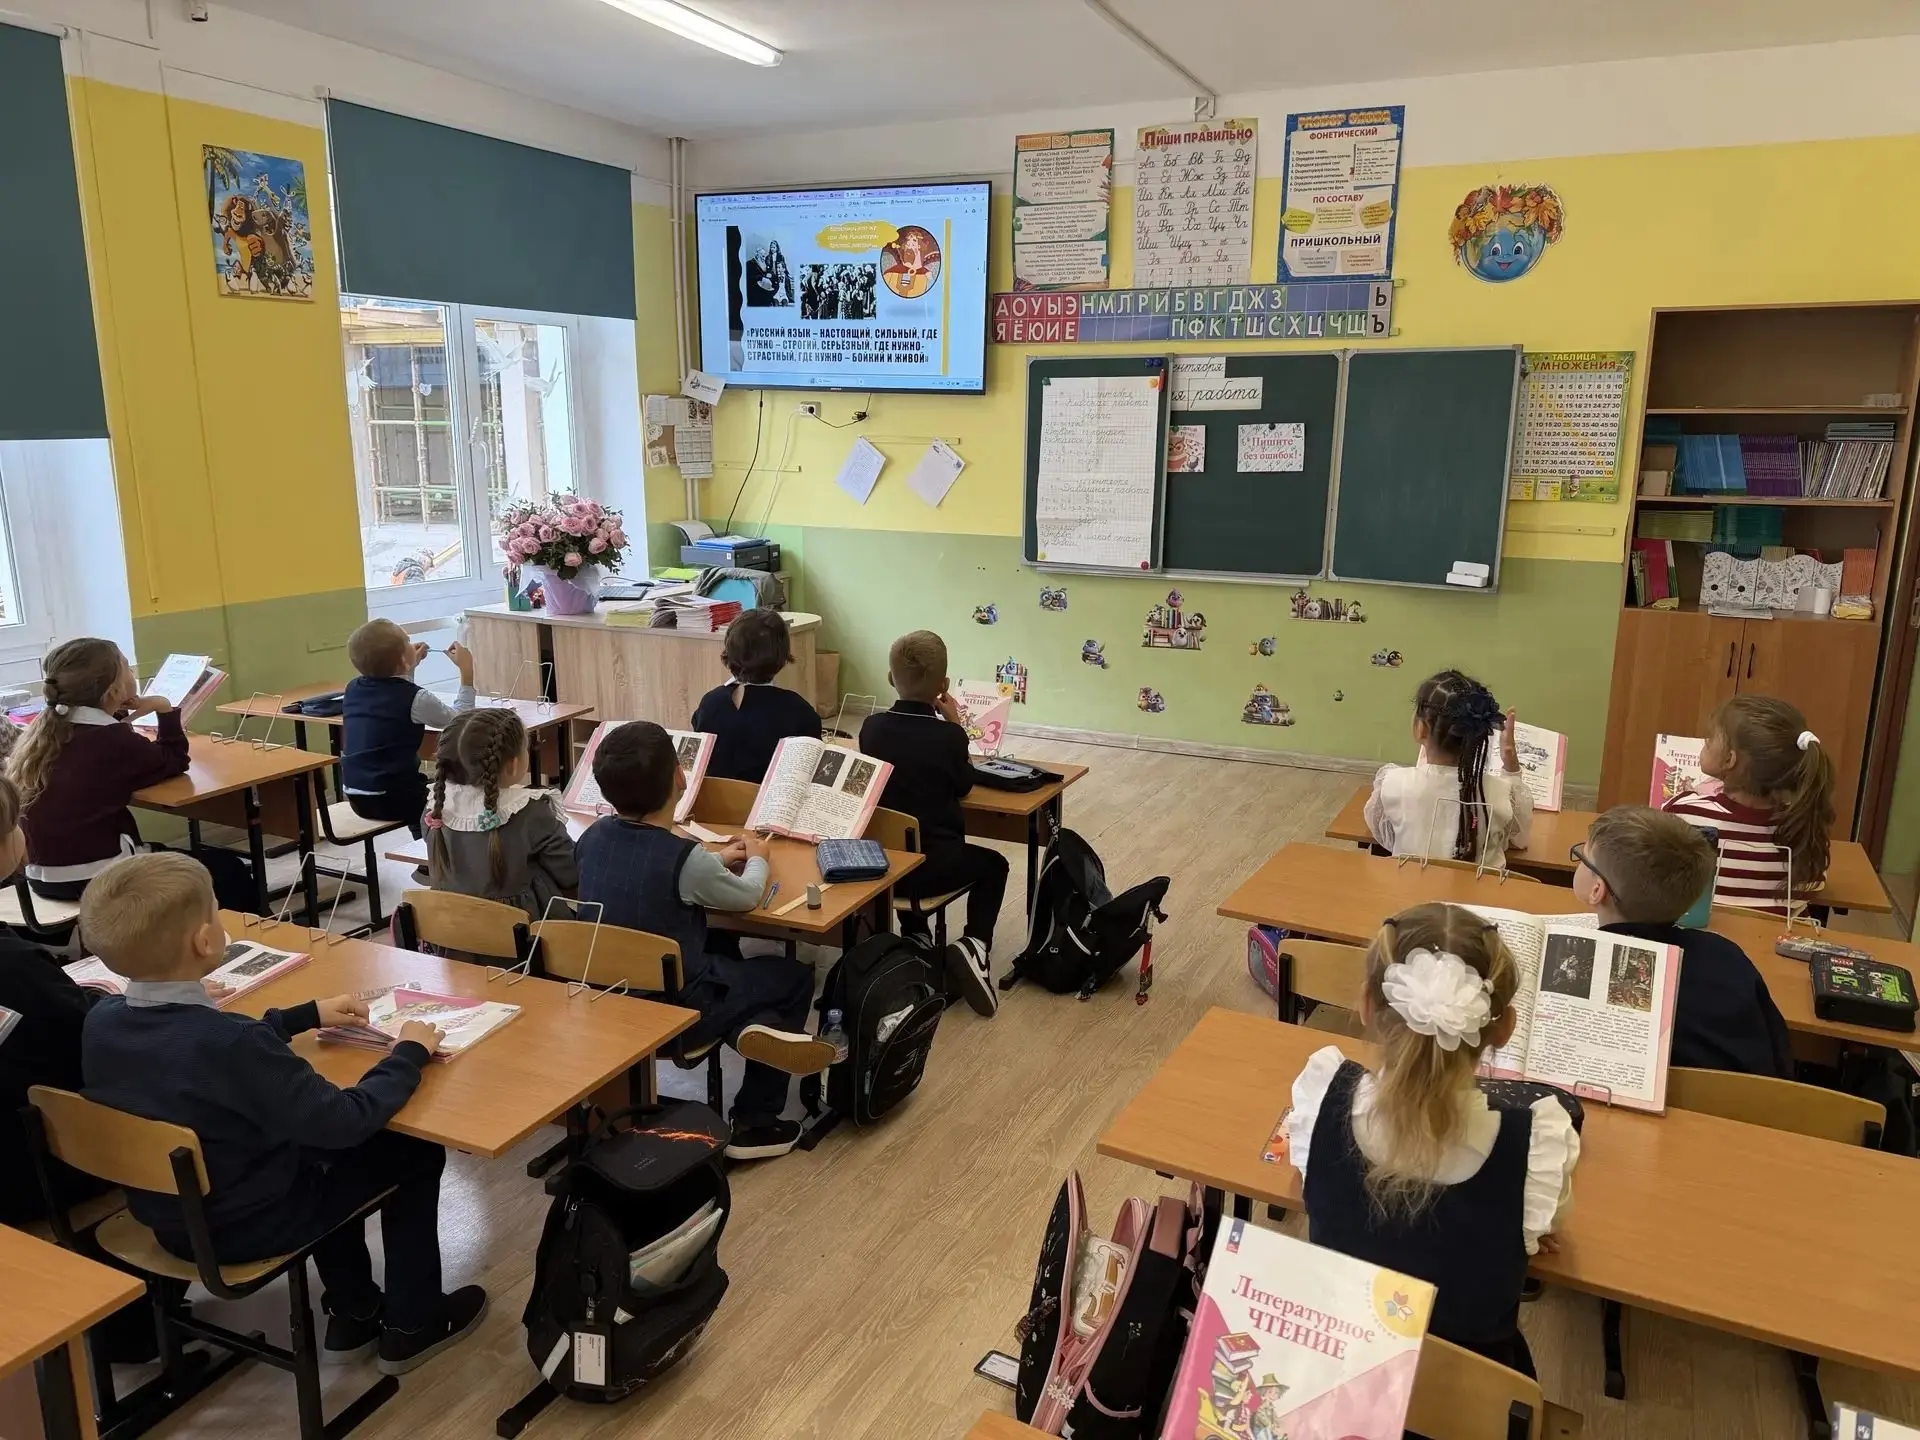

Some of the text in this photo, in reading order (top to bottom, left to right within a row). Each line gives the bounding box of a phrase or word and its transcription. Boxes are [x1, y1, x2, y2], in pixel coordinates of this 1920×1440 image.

[1184, 129, 1252, 143] ПРАВИЛЬНО
[1310, 127, 1377, 139] ФОНЕТИЧЕСКИЙ
[1327, 194, 1363, 203] СОСТАВУ
[1291, 234, 1381, 247] ПРИШКОЛЬНЫЙ
[788, 328, 810, 338] ЯЗЫК
[820, 327, 872, 339] НАСТОЯЩИЙ,
[875, 327, 920, 339] СИЛЬНЫЙ,
[922, 329, 938, 340] ГДЕ
[748, 340, 773, 349] НУЖНО
[783, 339, 819, 350] СТРОГИЙ,
[821, 339, 872, 351] СЕРЬЁЗНЫЙ,
[874, 341, 889, 352] ГДЕ
[748, 351, 796, 362] СТРАСТНЫЙ,
[798, 352, 812, 363] ГДЕ
[815, 353, 842, 362] НУЖНО
[852, 352, 885, 363] БОЙКИЙ
[887, 353, 892, 363] И
[1172, 356, 1224, 378] ентября
[1533, 361, 1616, 370] УМНОЖЕНИЯ
[1190, 380, 1260, 408] работа
[1252, 437, 1294, 446] Пишите
[1244, 450, 1297, 459] без ошибок!
[982, 721, 1001, 743] 3
[1667, 749, 1700, 760] Литера
[1232, 1274, 1376, 1343] Литературное
[1249, 1306, 1348, 1360] ЧТЕНИЕ
